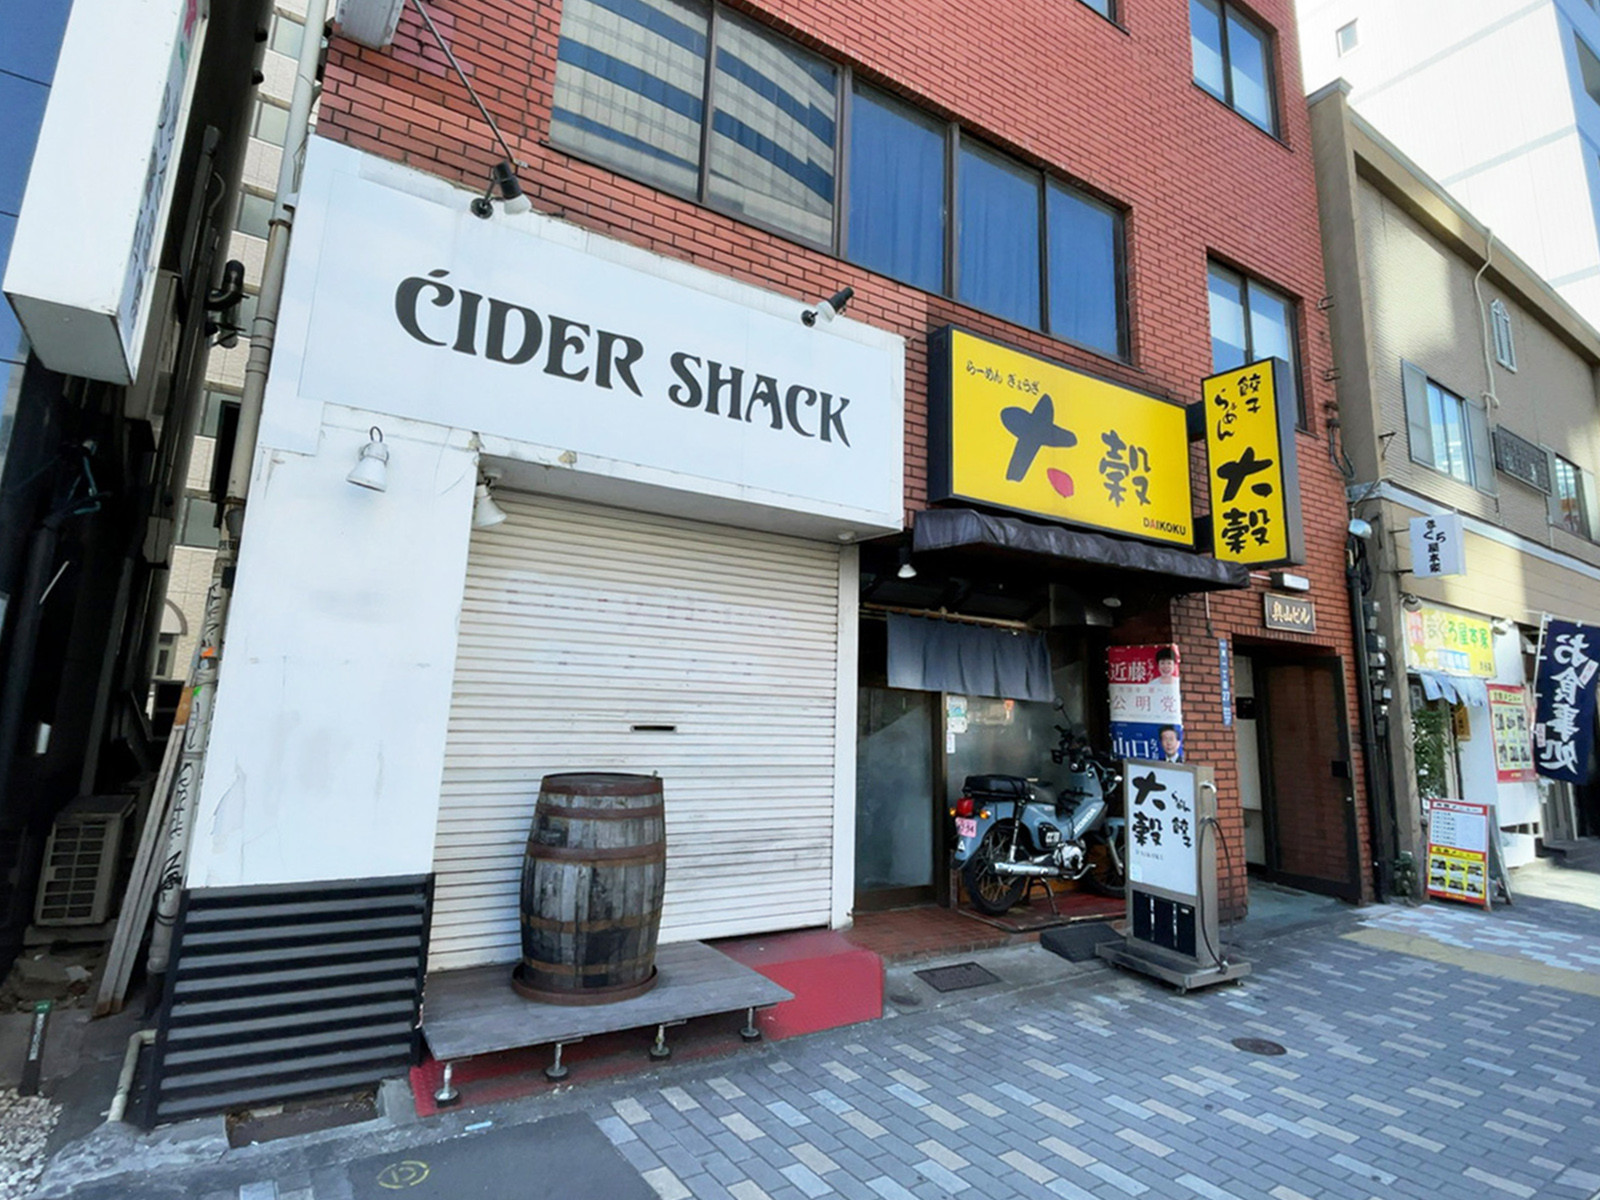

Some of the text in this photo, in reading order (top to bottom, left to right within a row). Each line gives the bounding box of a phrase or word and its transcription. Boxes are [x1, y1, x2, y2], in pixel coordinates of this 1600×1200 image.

[966, 360, 1003, 384] らーめん
[668, 352, 851, 447] SHACK
[1237, 373, 1261, 414] 餃子
[1000, 393, 1152, 508] 大穀
[1216, 446, 1274, 554] 大穀
[1143, 517, 1187, 536] DAIKOKU
[1109, 661, 1147, 682] 近藤
[1113, 695, 1177, 713] 公明党
[1112, 737, 1150, 759] 山口
[1132, 771, 1167, 847] 大穀
[1171, 816, 1192, 848] 餃子
